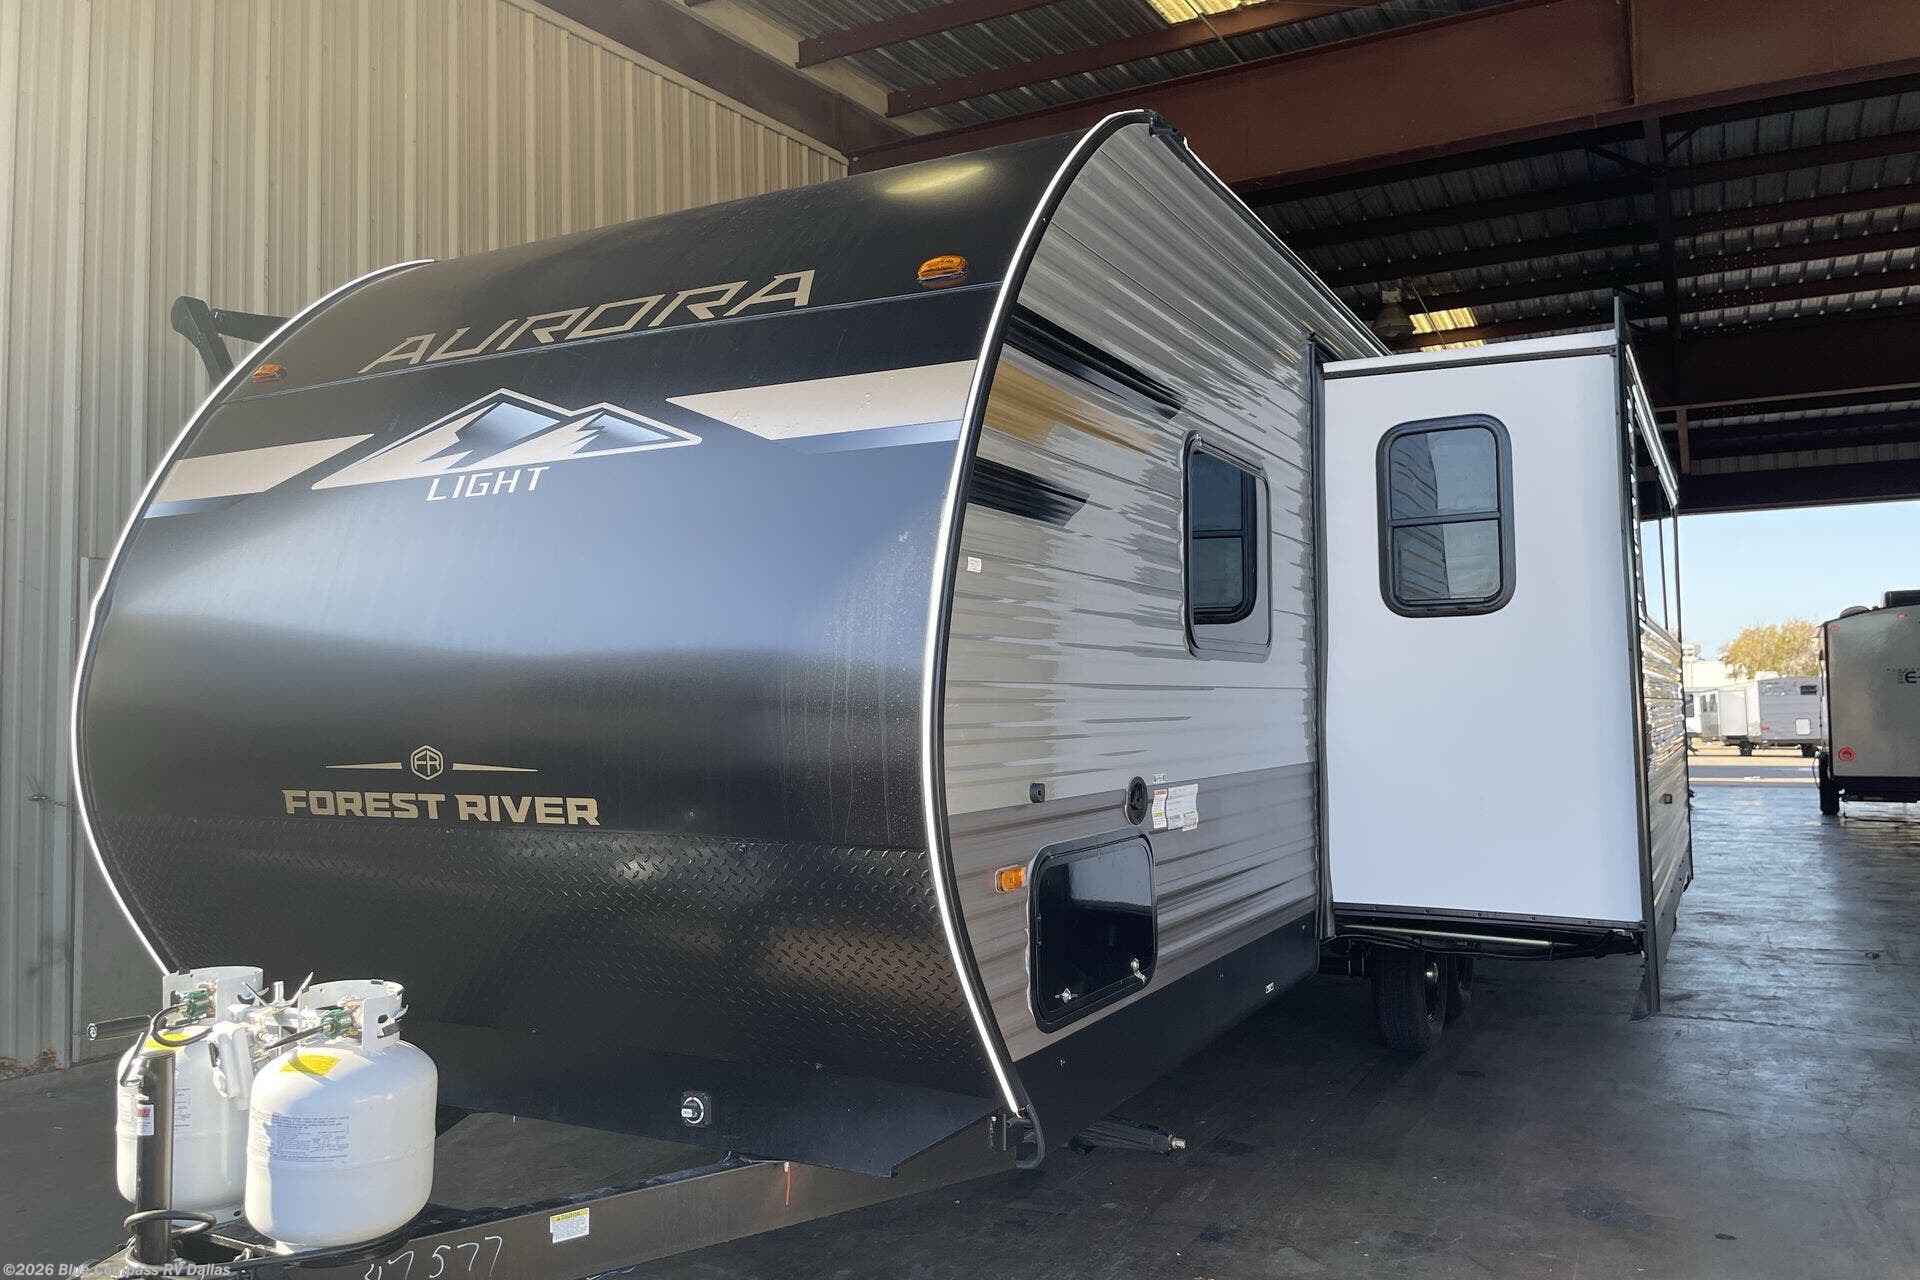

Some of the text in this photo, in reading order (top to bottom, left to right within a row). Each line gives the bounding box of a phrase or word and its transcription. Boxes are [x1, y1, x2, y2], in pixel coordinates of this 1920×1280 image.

[358, 269, 816, 374] AURORA
[426, 466, 550, 502] LIGHT
[281, 789, 601, 827] FOREST RIVER
